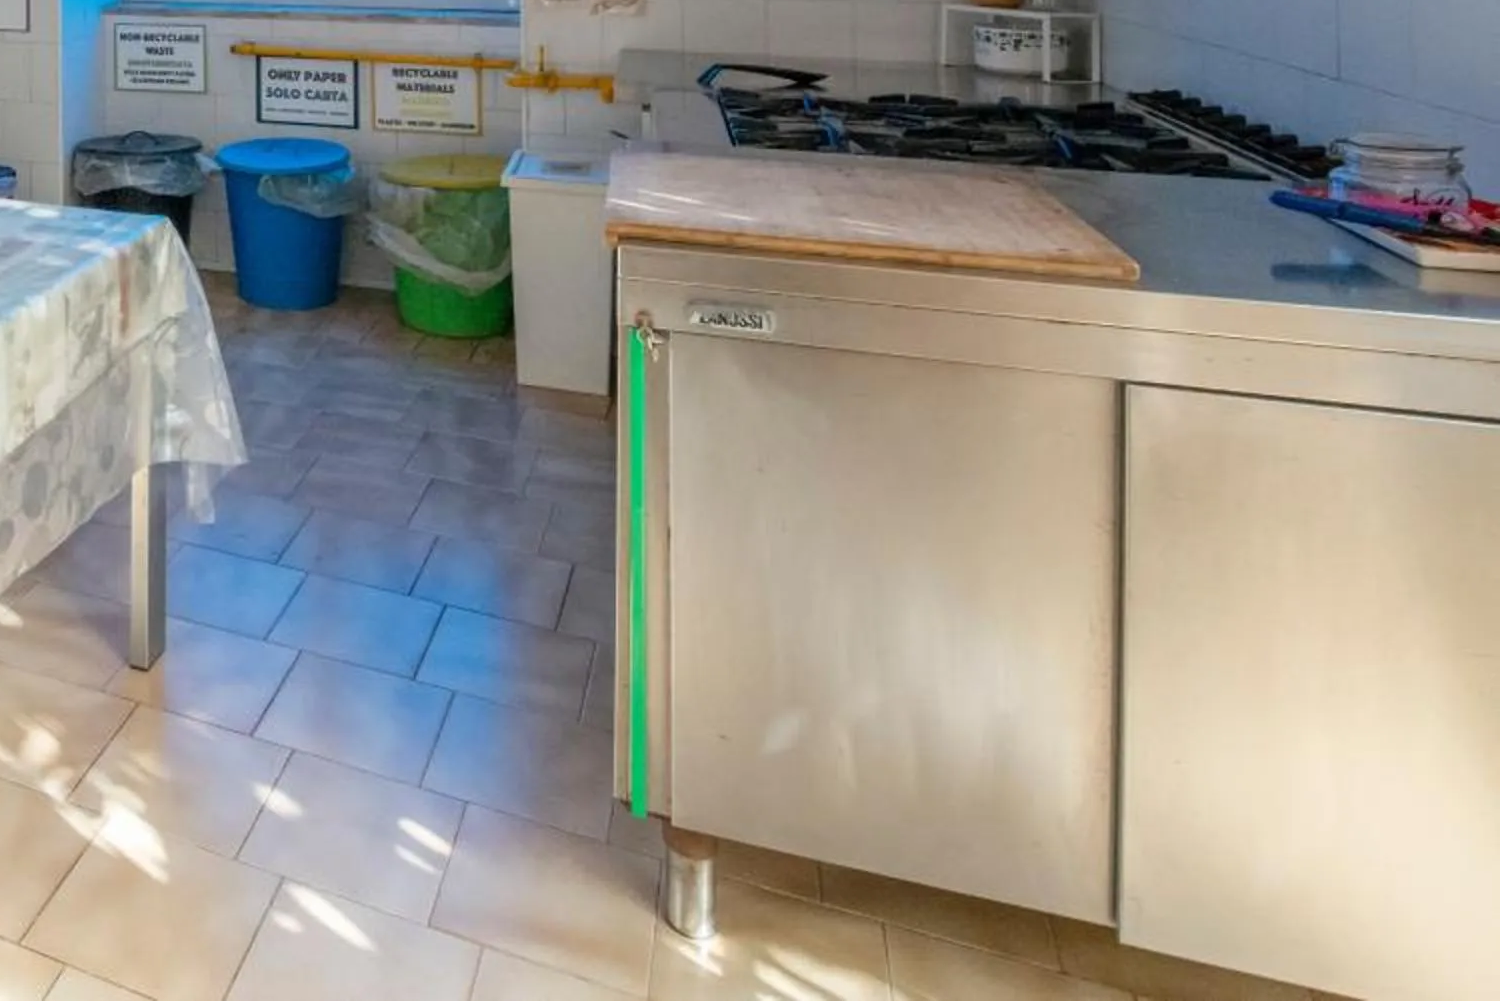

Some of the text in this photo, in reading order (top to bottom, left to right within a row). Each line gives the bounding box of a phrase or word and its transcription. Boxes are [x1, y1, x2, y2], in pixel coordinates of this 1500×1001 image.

[267, 67, 348, 84] ONLY PAPER
[265, 86, 349, 103] SOLO CARTA
